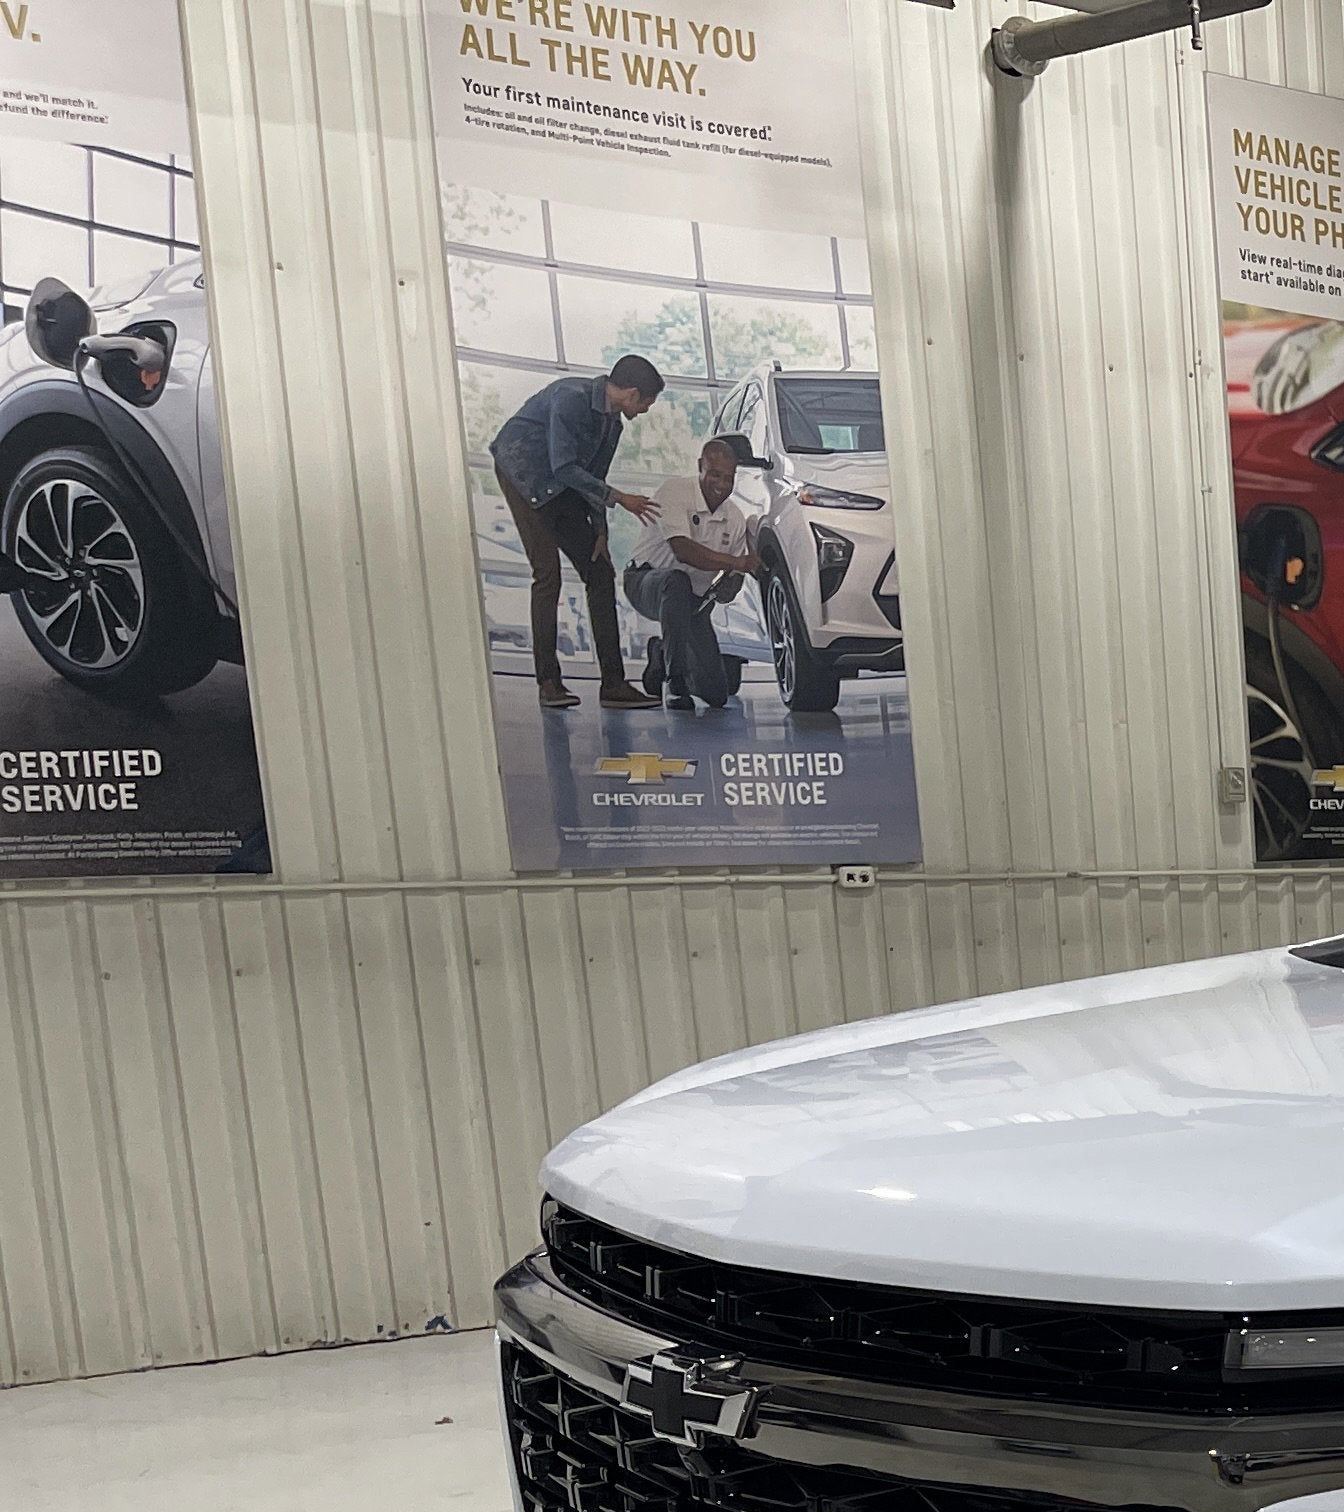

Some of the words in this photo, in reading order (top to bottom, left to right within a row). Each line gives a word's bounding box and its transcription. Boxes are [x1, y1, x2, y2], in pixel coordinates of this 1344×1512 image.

[460, 0, 574, 32] ERE
[583, 3, 678, 50] WITH
[688, 21, 757, 62] YOU
[460, 24, 531, 68] ALL
[540, 38, 612, 82] THE
[621, 52, 706, 97] WAY.
[2, 90, 23, 101] and
[24, 93, 49, 104] we'll
[51, 96, 85, 108] match
[31, 107, 49, 117] the
[462, 77, 501, 98] Your
[505, 85, 542, 107] first
[546, 96, 649, 124] maintenance
[652, 111, 687, 130] visit
[691, 115, 703, 132] is
[463, 103, 504, 119] Includes:
[505, 111, 516, 120] oil
[517, 114, 533, 124] and
[534, 116, 545, 126] oil
[546, 117, 568, 130] filter
[569, 122, 602, 136] change,
[604, 127, 628, 139] diesel
[629, 132, 661, 145] exhaust
[662, 136, 681, 147] fluid
[682, 140, 701, 150] tank
[464, 115, 491, 129] 4-tire
[492, 121, 529, 136] rotation,
[531, 128, 546, 138] and
[548, 131, 594, 146] Multi-Point
[596, 138, 625, 151] Vehicle
[626, 144, 672, 158] Inspection.
[1232, 128, 1342, 178] MANAGE
[1234, 165, 1343, 214] VEHICLE
[1235, 201, 1306, 243] YOUR
[1239, 247, 1267, 267] View
[1270, 255, 1323, 276] real-time
[1276, 274, 1325, 295] available
[1328, 285, 1342, 297] on
[0, 749, 162, 779] CERTIFIED
[720, 752, 844, 778] CERTIFIED
[2, 783, 139, 813] SERVICE
[592, 792, 705, 806] CHEVROLET
[723, 781, 828, 807] SERVICE
